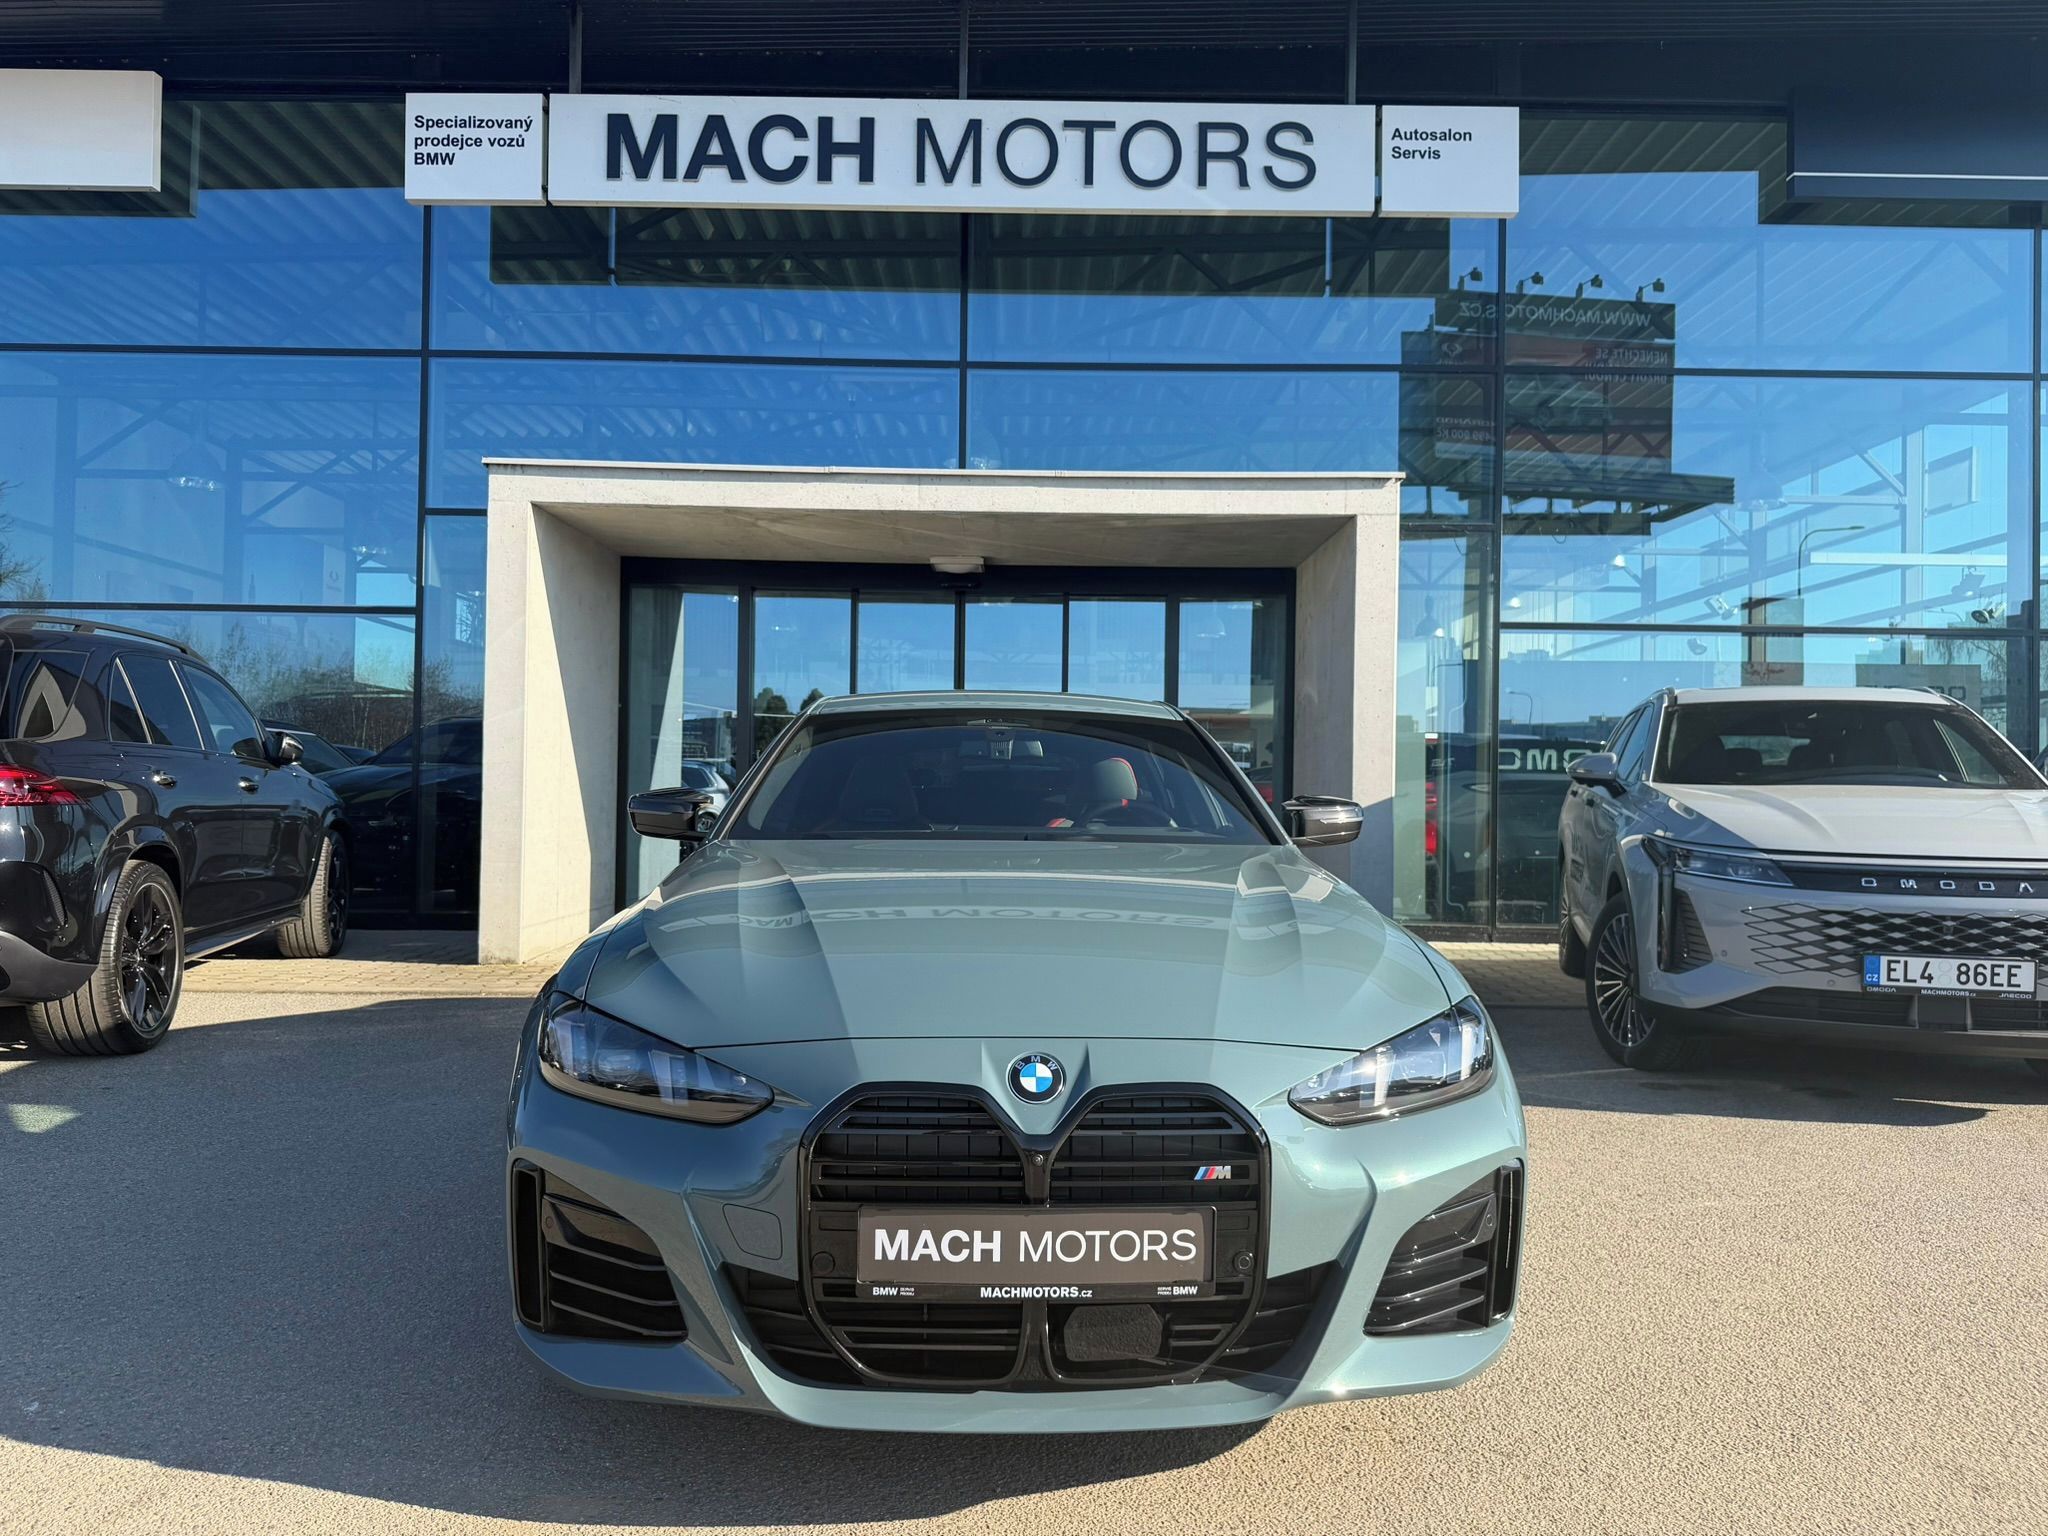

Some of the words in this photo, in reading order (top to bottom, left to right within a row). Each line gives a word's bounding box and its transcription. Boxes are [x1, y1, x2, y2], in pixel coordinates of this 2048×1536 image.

[414, 114, 533, 132] Specializovaný
[414, 133, 482, 151] prodejce
[487, 131, 528, 148] vozů
[1391, 128, 1473, 142] Autosalon
[414, 152, 456, 166] BMW
[606, 113, 876, 183] MACH
[916, 117, 1317, 191] MOTORS
[1391, 146, 1441, 160] Servis
[1861, 877, 2034, 894] OMODA
[1866, 973, 1879, 982] CZ
[1886, 959, 1934, 984] EL4
[1956, 962, 2022, 988] 86EE
[1015, 1055, 1058, 1071] BMW
[874, 1228, 1002, 1263] MACH
[1019, 1228, 1197, 1263] MOTORS
[872, 1287, 898, 1297] BMW
[980, 1286, 1093, 1299] MACHMOTORS.cz
[1172, 1285, 1198, 1296] BMW
